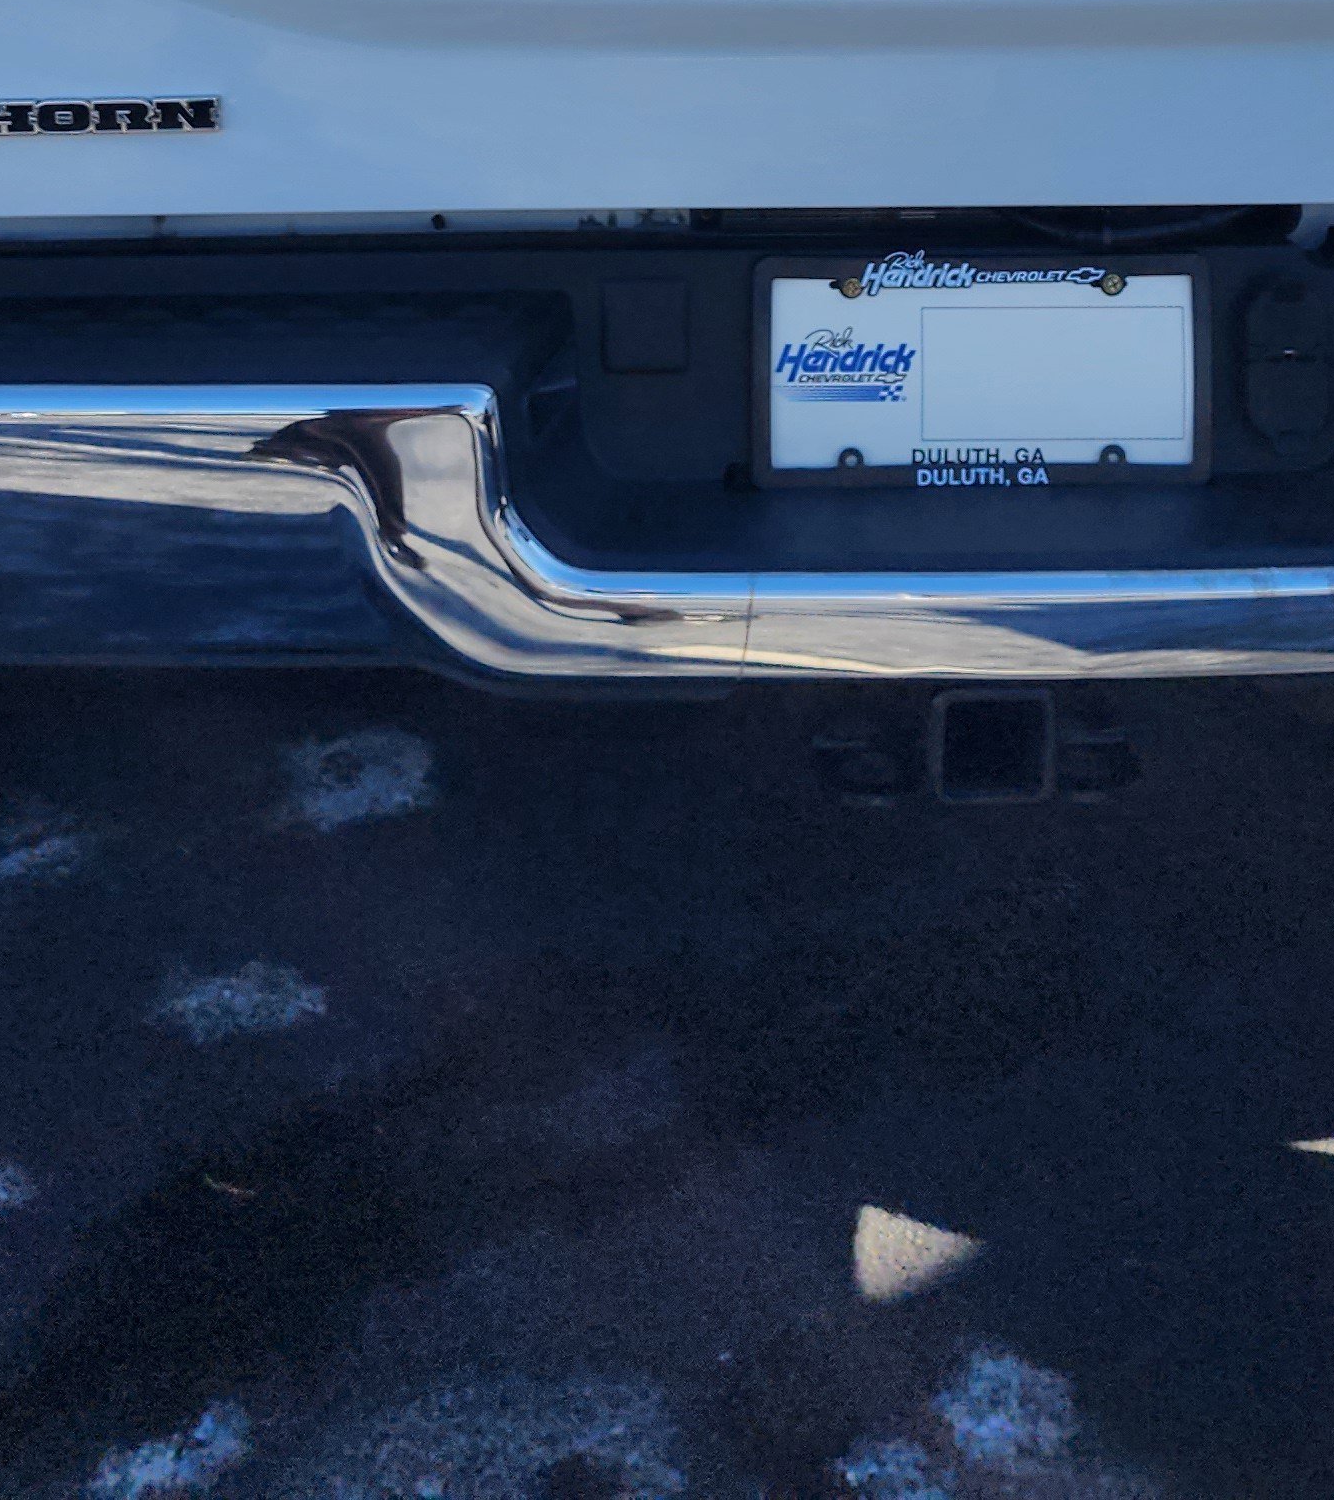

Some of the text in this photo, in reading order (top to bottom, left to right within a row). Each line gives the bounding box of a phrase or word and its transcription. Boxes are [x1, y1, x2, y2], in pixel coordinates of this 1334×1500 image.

[884, 249, 926, 270] Rick
[861, 262, 1067, 296] Hendrick CHEVROLET
[805, 326, 854, 350] Rick
[776, 343, 916, 383] Hendrick
[798, 373, 876, 383] CHEVROLET
[1016, 448, 1046, 465] GA
[917, 466, 1049, 486] DULUTH, GA
